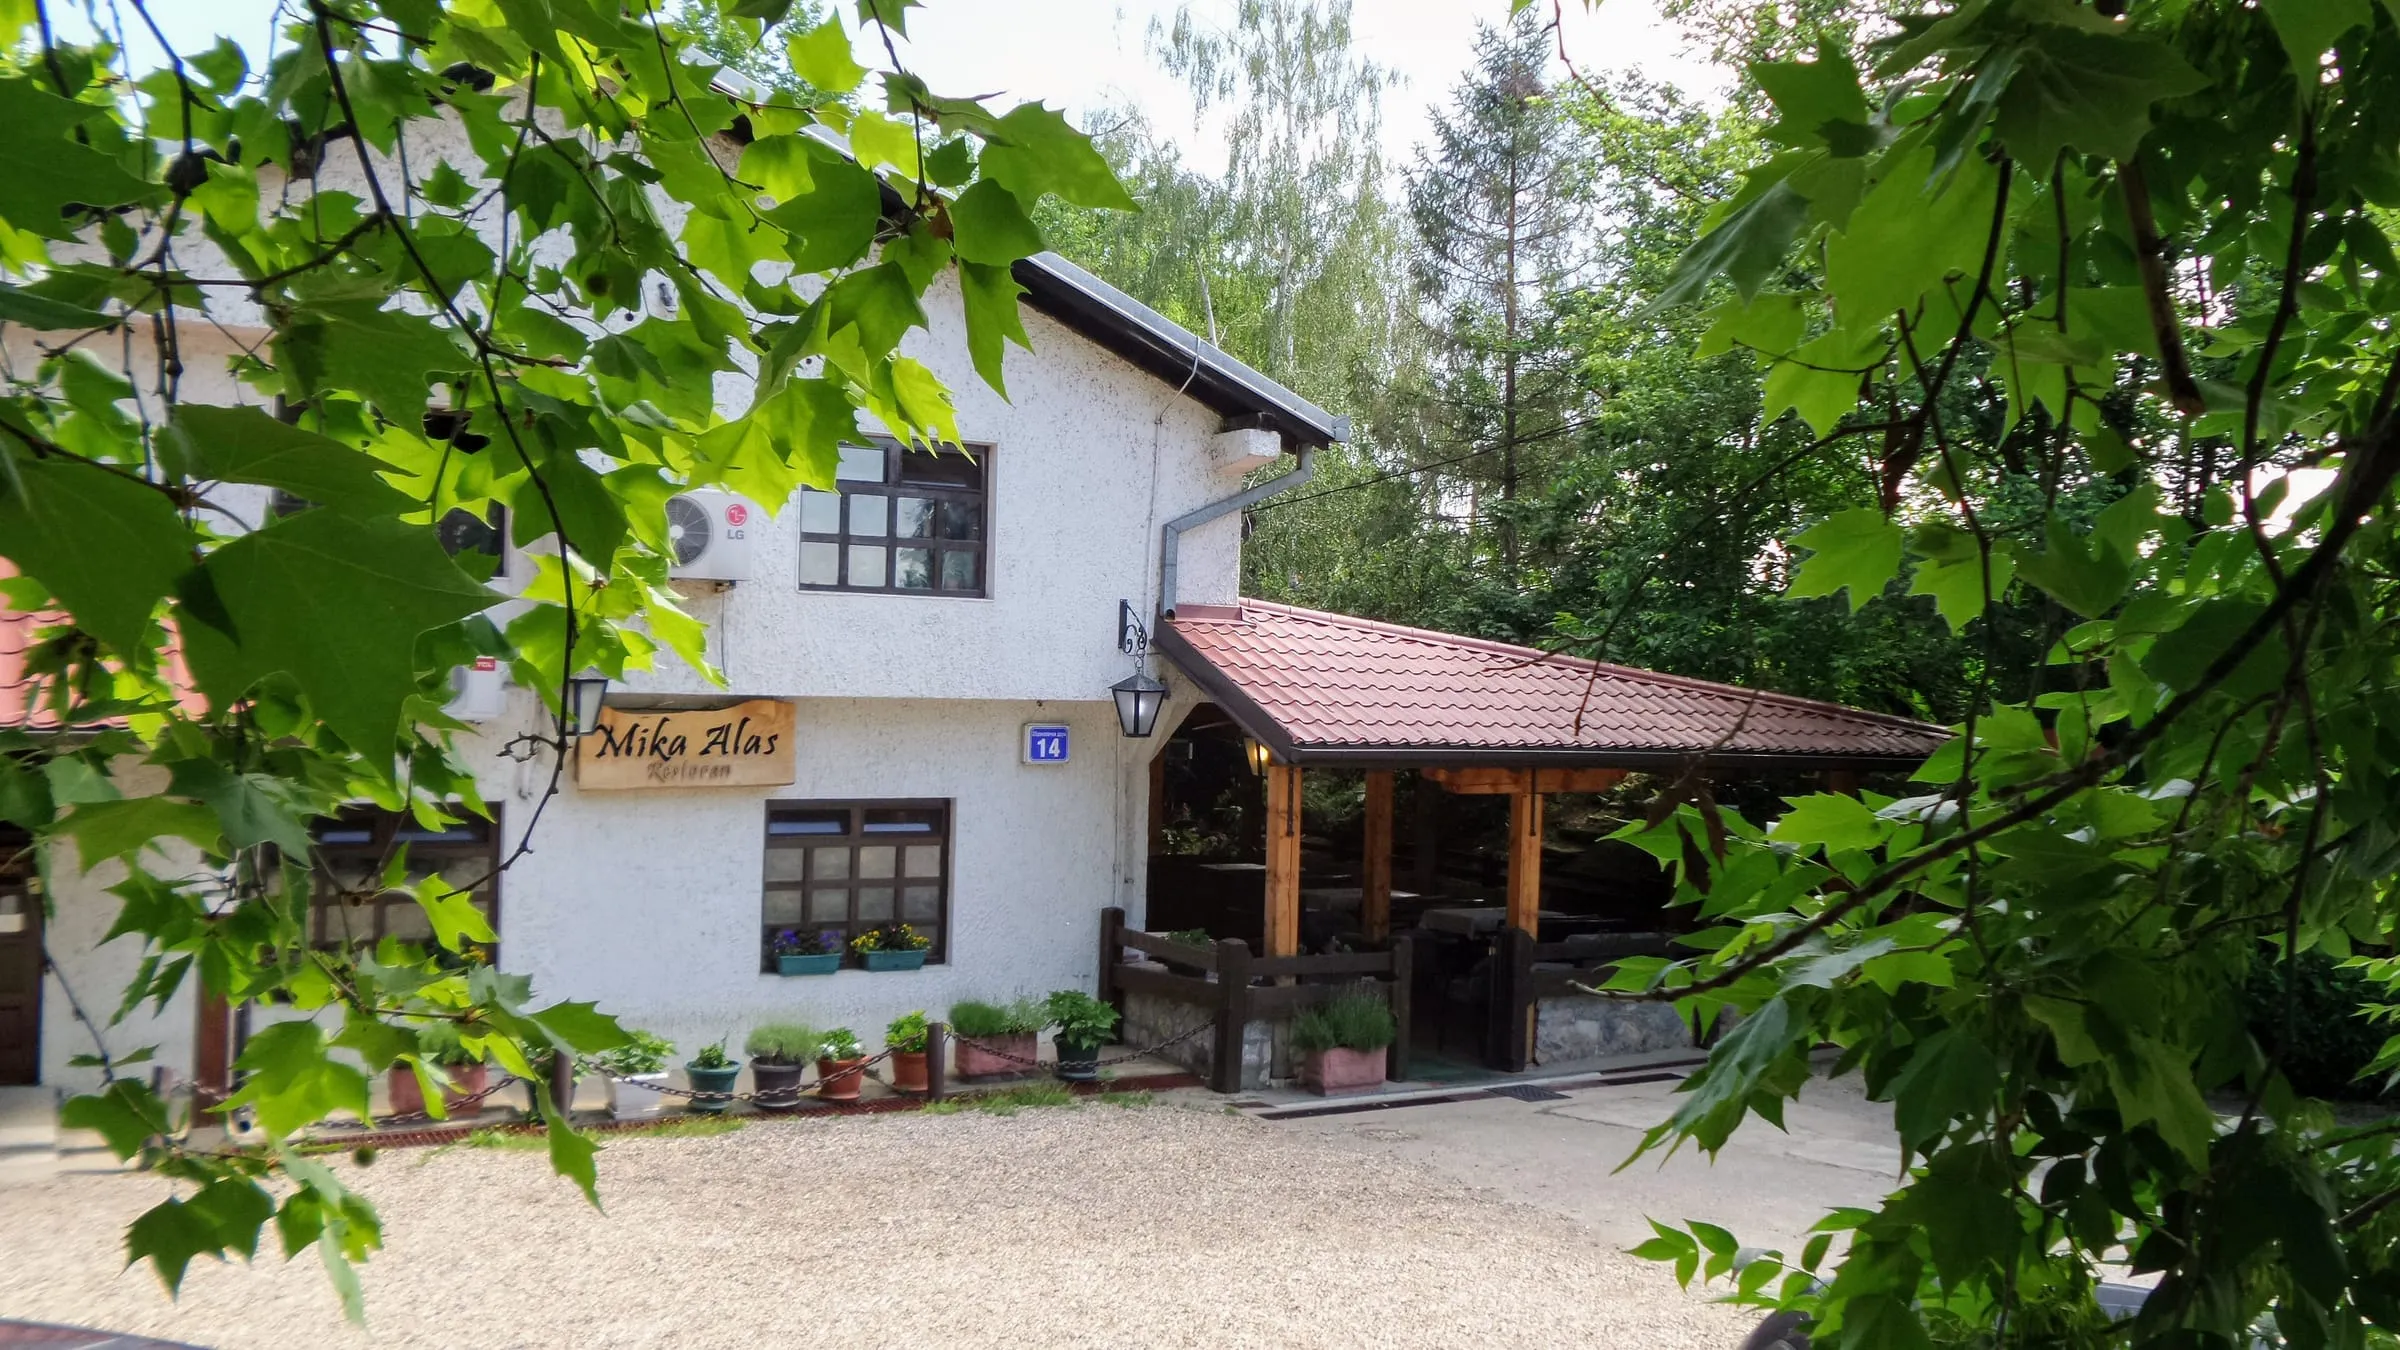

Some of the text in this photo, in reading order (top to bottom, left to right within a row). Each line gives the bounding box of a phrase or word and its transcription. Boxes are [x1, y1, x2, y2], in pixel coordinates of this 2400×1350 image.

[727, 529, 745, 540] LG
[594, 716, 779, 761] Mika Alas
[1037, 738, 1060, 757] 14
